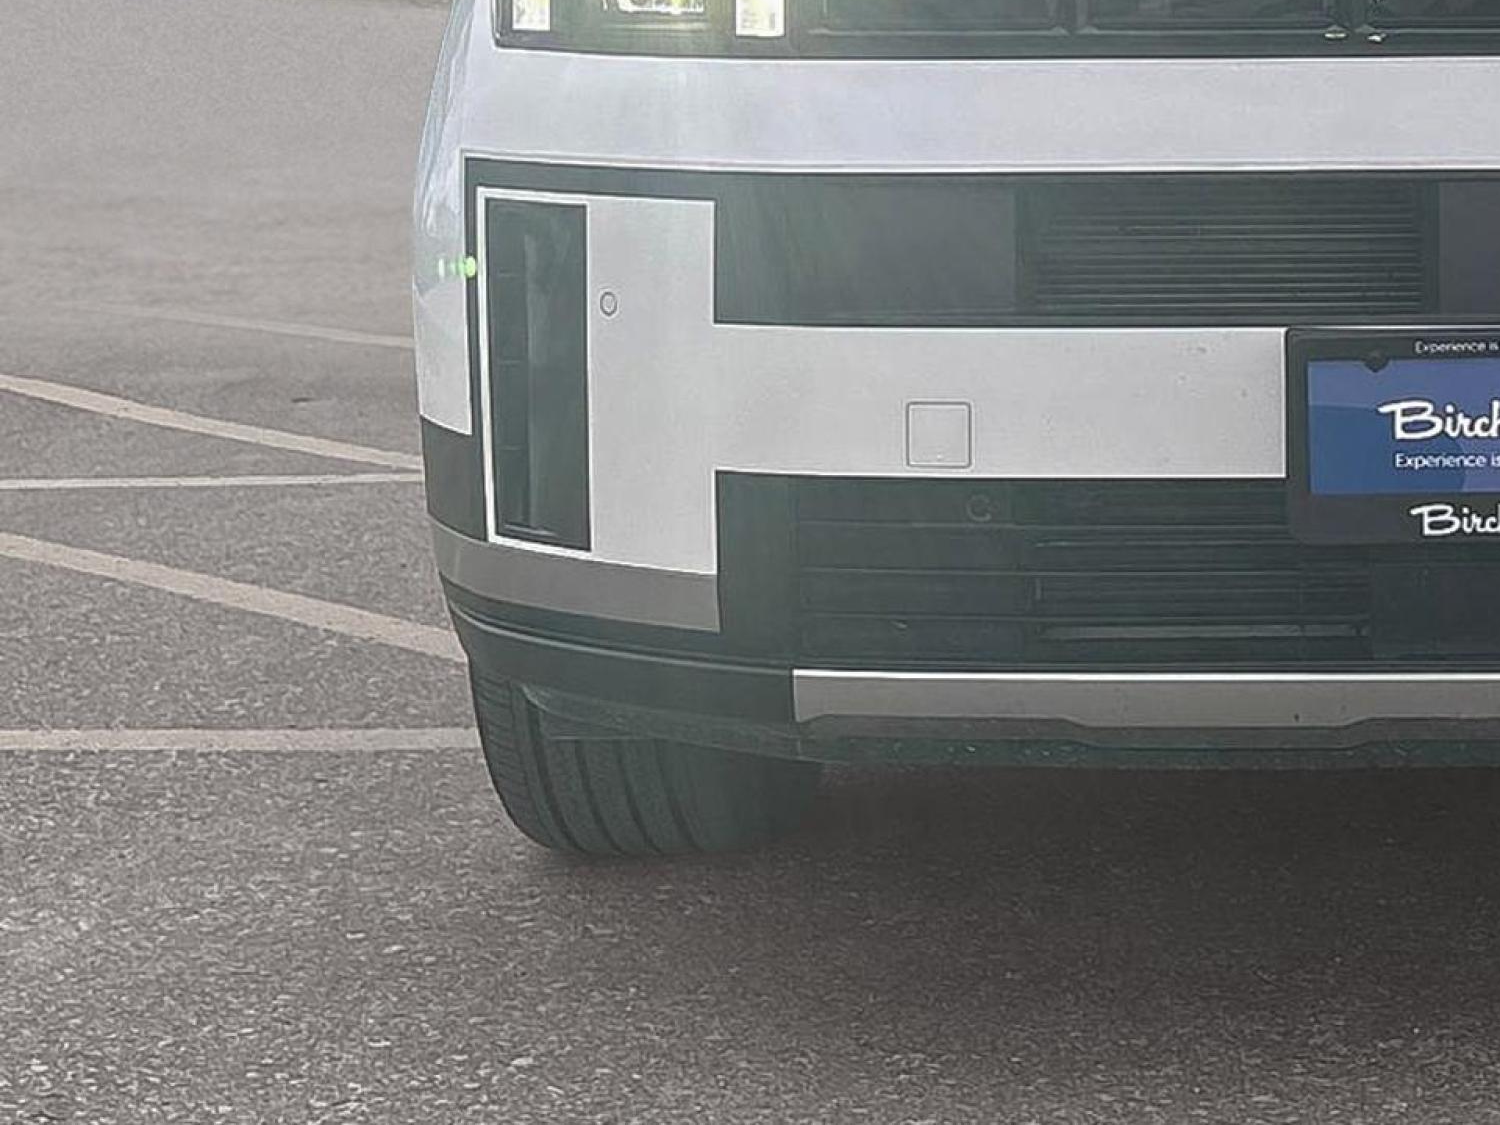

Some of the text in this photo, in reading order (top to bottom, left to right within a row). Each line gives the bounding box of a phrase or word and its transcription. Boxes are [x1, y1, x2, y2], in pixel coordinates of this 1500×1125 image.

[1415, 341, 1485, 354] Experience
[1489, 341, 1499, 351] is
[1395, 453, 1487, 470] Experience
